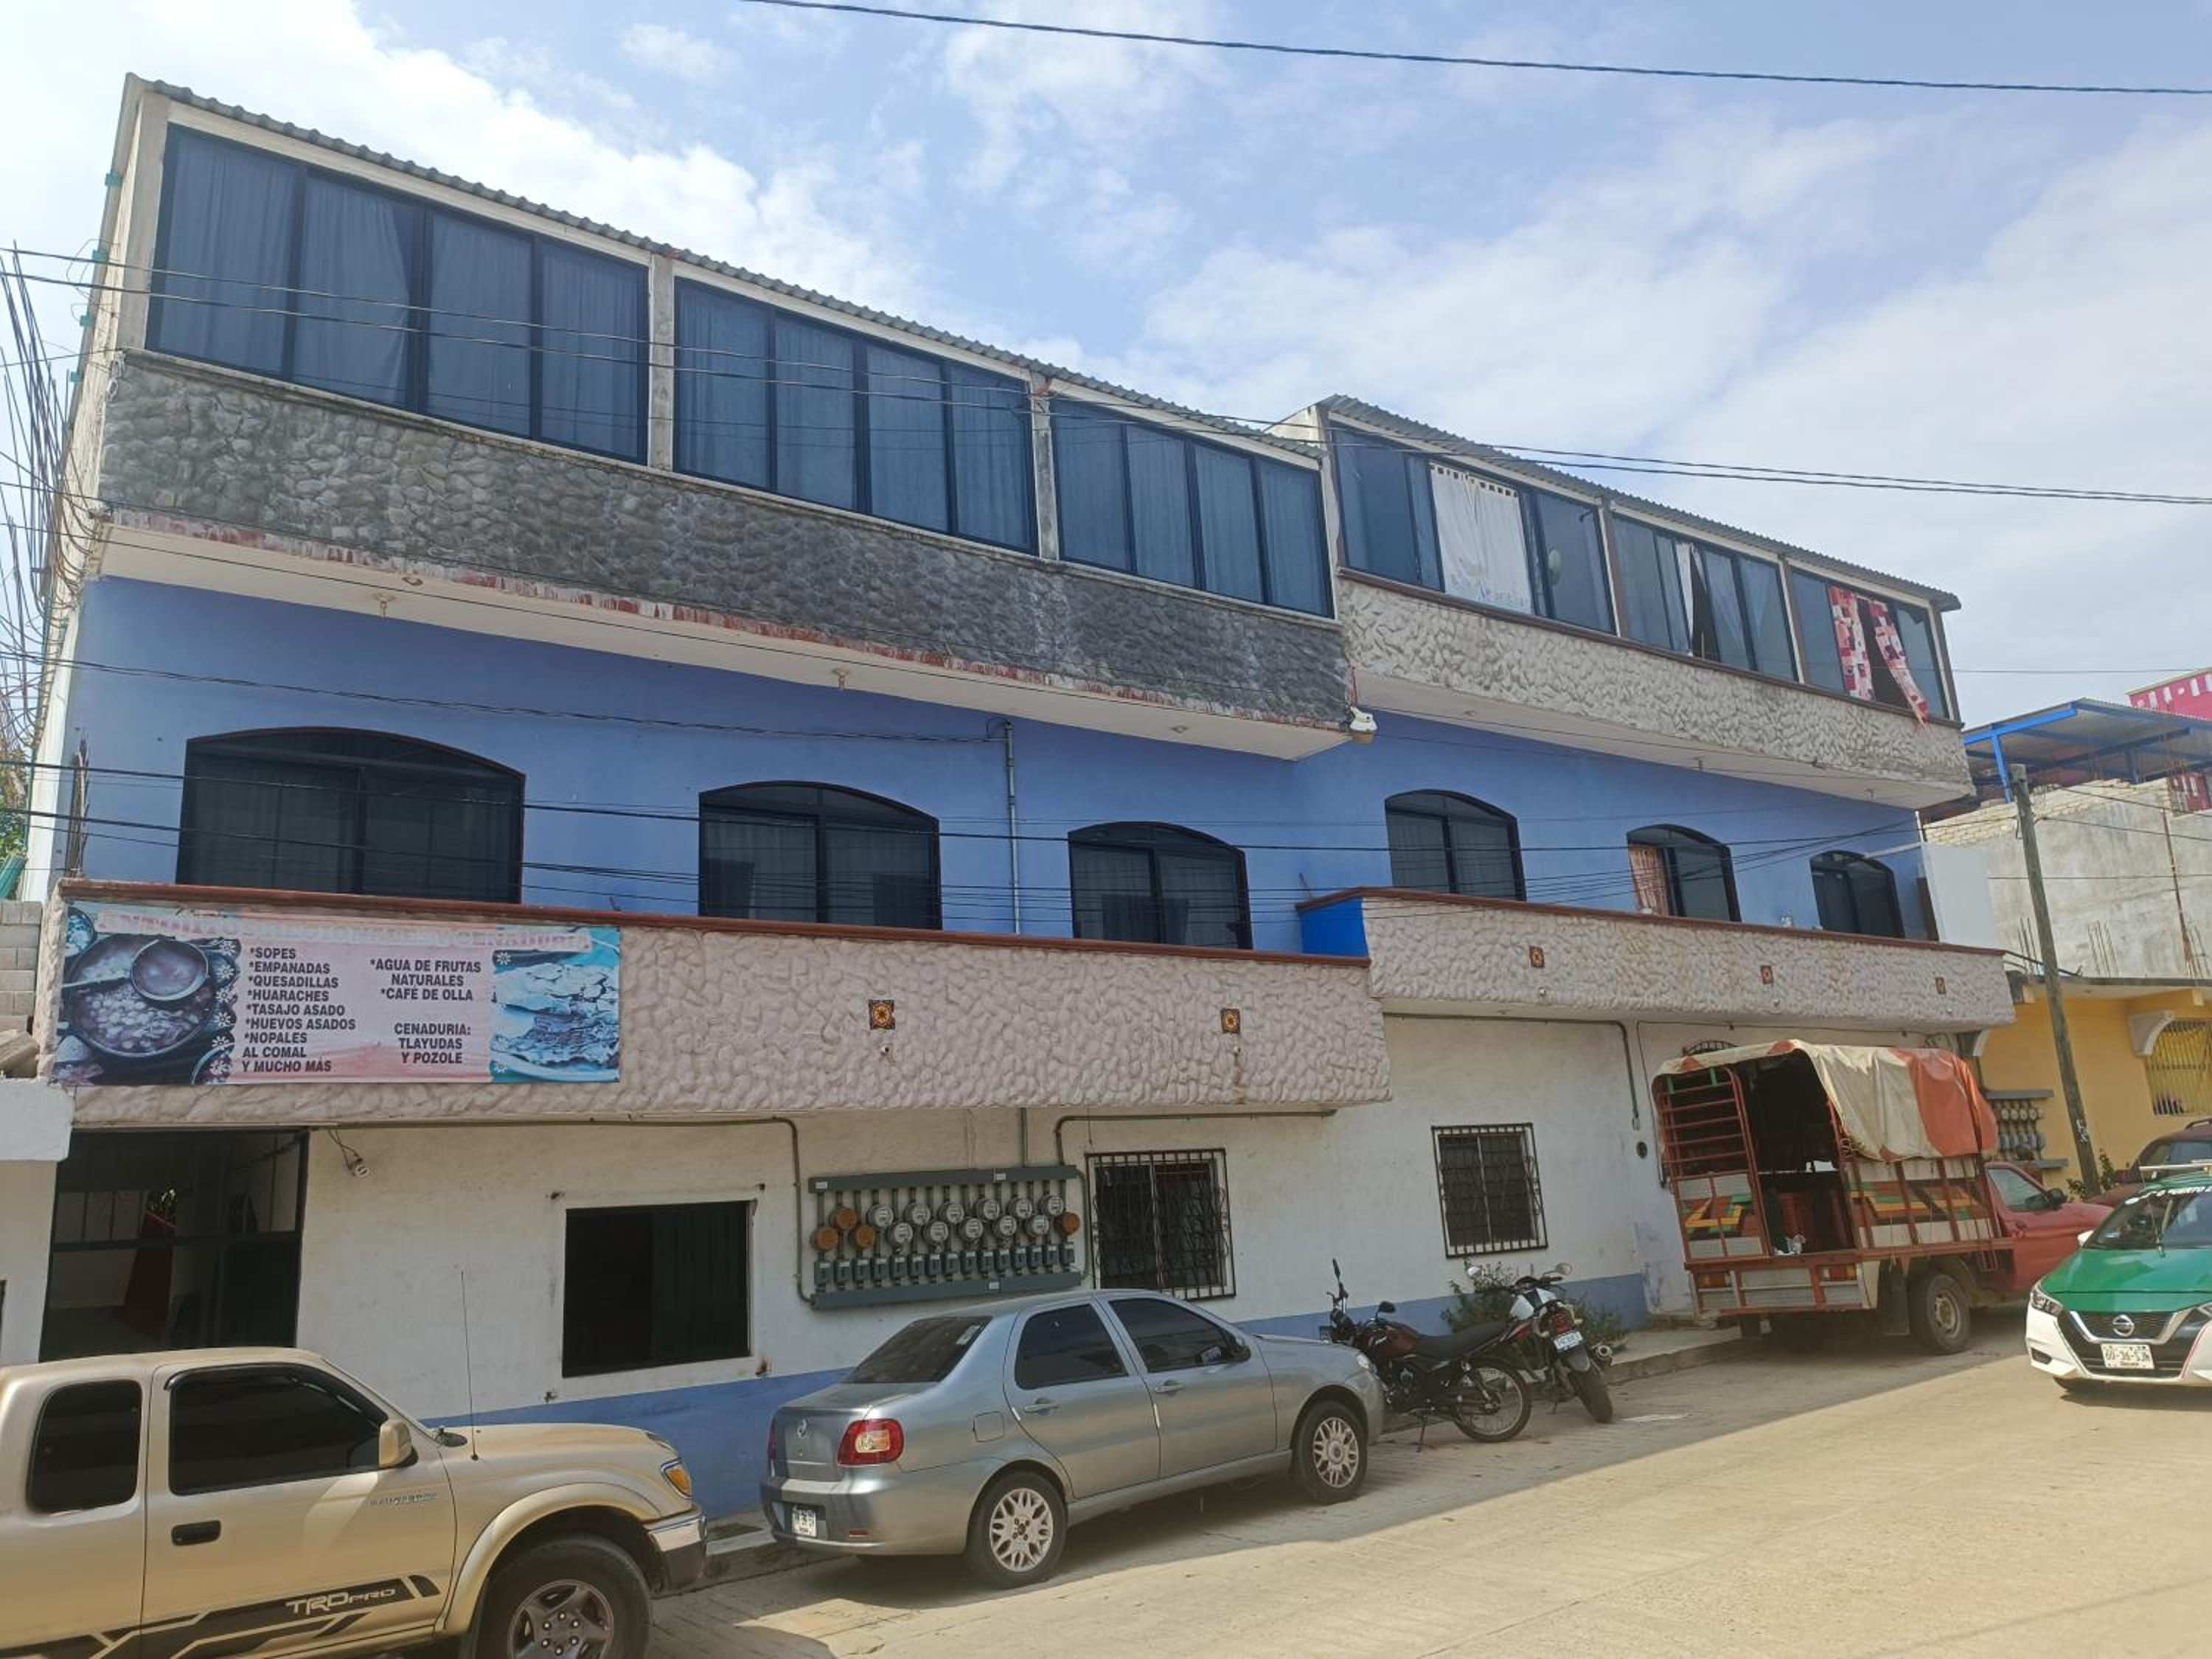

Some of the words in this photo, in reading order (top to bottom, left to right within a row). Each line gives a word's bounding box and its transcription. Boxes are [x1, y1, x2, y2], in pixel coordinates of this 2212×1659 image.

[415, 960, 431, 972] DE
[435, 960, 481, 973] FRUTAS
[392, 974, 464, 987] NATURALES
[422, 989, 439, 1001] DE
[442, 989, 473, 1001] OLLA
[304, 1004, 345, 1016] ASADO
[307, 1019, 356, 1030] ASADOS
[394, 1023, 471, 1035] CENADURIA:
[399, 1037, 462, 1049] TLAYUDAS
[243, 1047, 258, 1057] AL
[262, 1046, 307, 1057] COMAL
[401, 1052, 410, 1063] Y
[413, 1052, 463, 1063] POZOLE
[242, 1061, 251, 1072] Y
[254, 1061, 302, 1072] MUCHO
[285, 1592, 349, 1615] TRD
